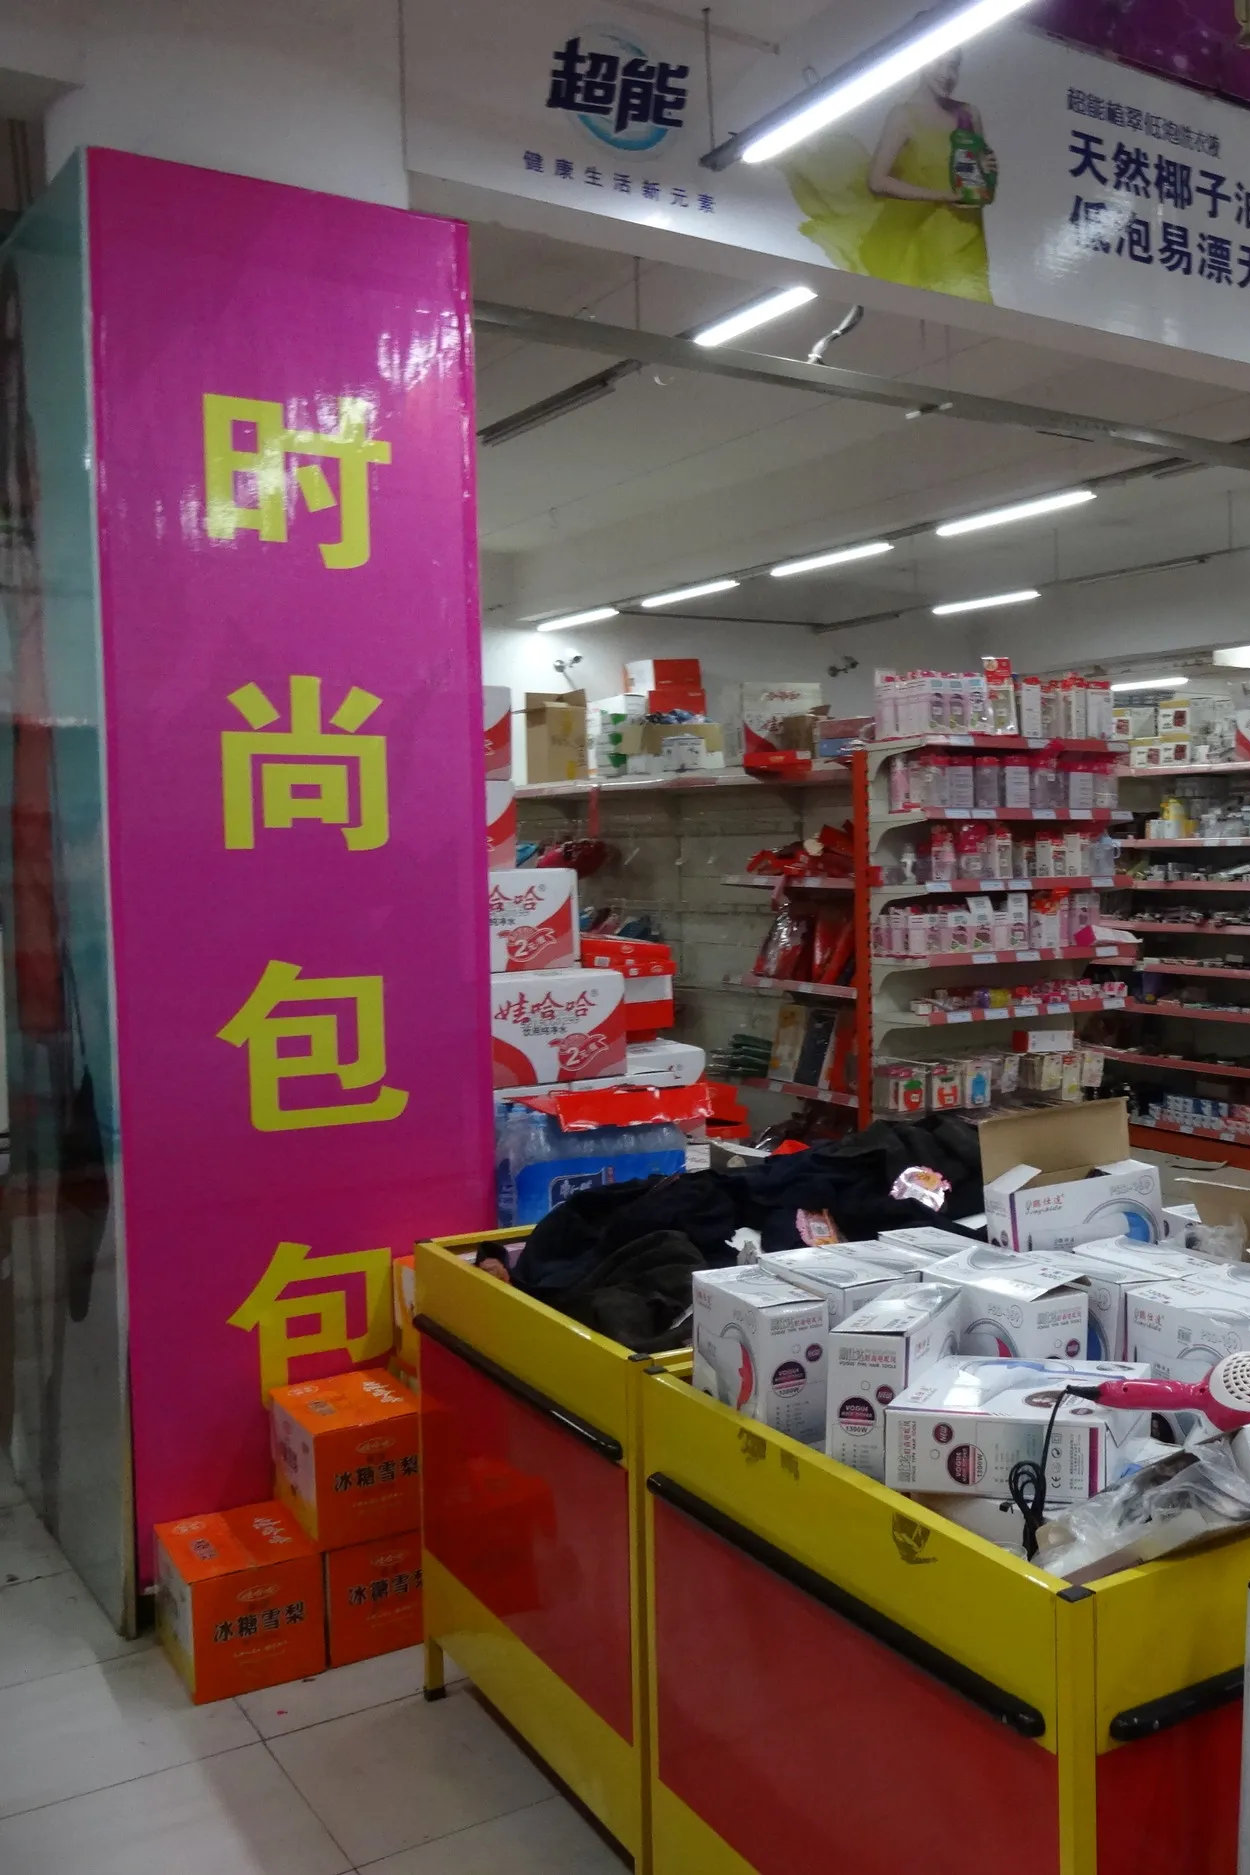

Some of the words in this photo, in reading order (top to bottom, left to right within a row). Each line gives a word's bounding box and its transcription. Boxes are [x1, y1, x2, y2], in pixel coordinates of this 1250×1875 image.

[546, 36, 689, 133] 超能
[523, 150, 716, 214] 健康生活新元素
[202, 391, 411, 1410] 时尚包包
[494, 990, 597, 1025] 娃哈哈
[845, 1404, 869, 1412] VOGUE
[334, 1454, 420, 1492] 冰糖雪梨
[212, 1600, 306, 1643] 冰糖雪梨
